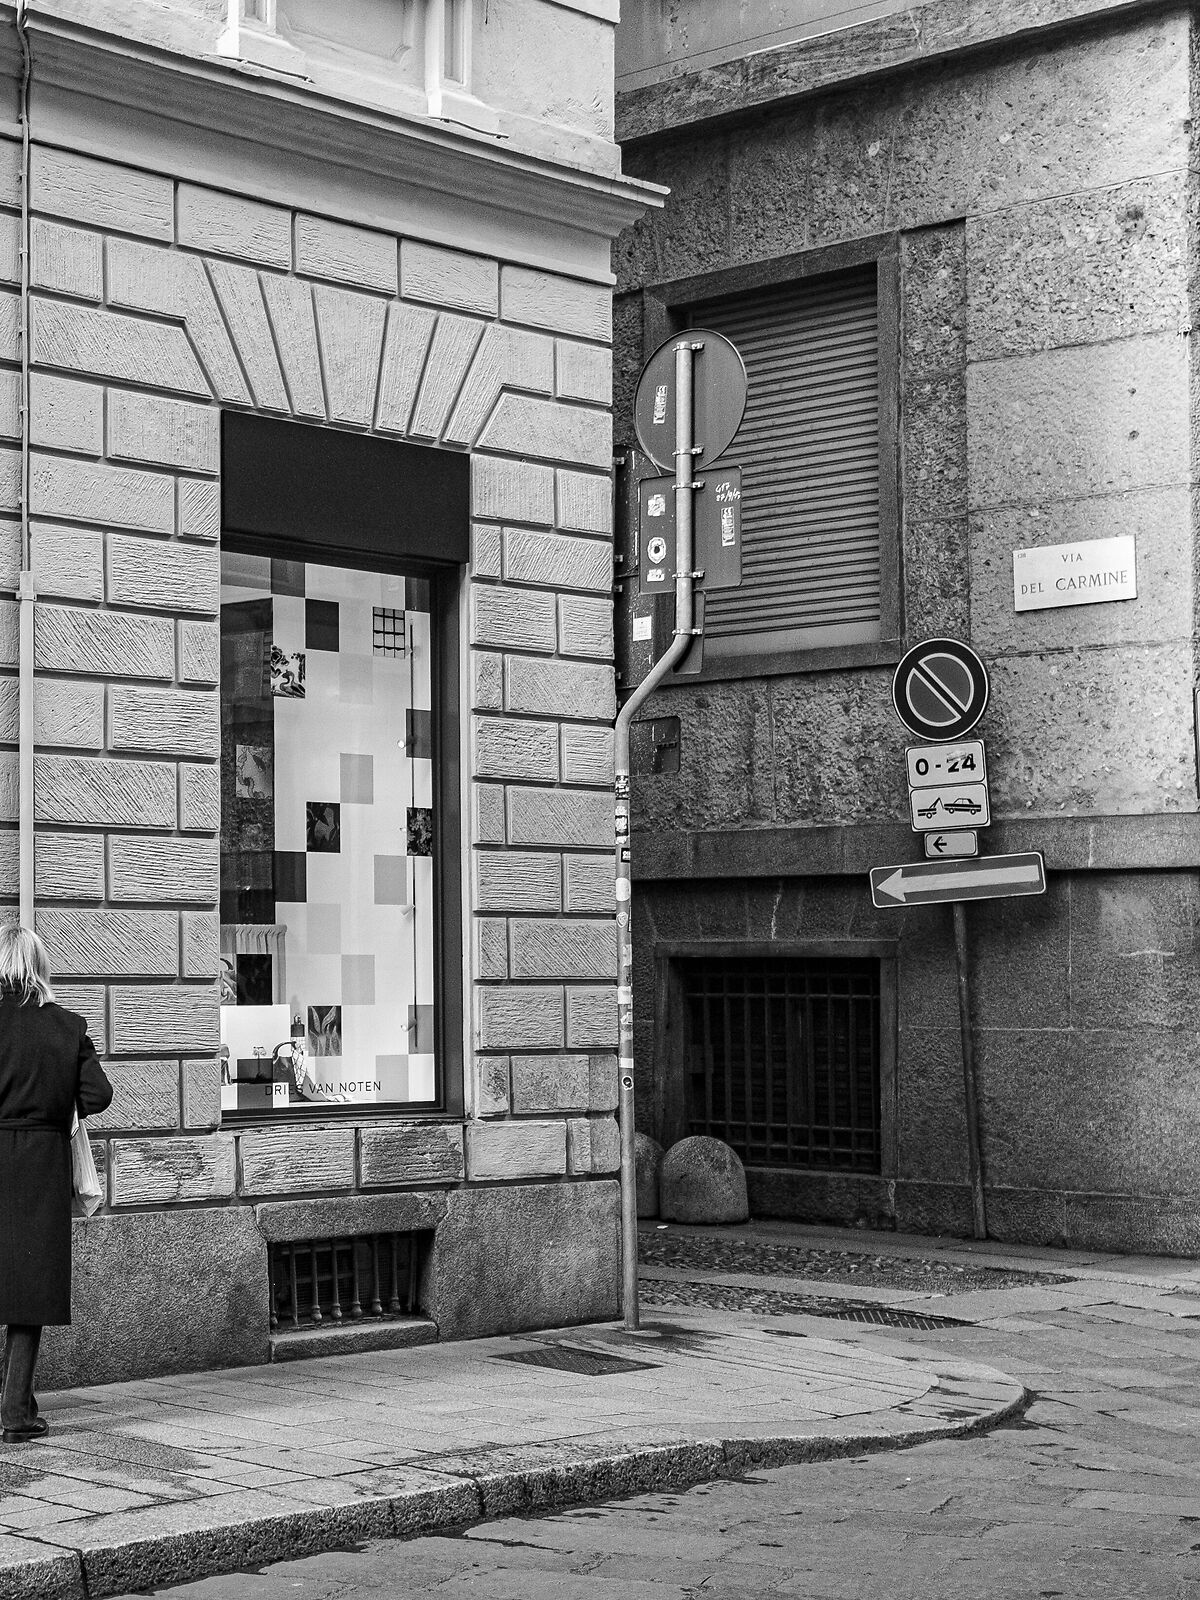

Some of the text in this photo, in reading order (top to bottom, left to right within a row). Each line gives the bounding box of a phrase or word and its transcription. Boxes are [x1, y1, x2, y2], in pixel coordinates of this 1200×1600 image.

[1061, 553, 1083, 563] VIA
[1021, 570, 1128, 595] DEL CARMINE
[915, 758, 929, 776] 0
[946, 753, 977, 773] 24
[265, 1081, 381, 1096] DRIES VAN NOTEN
